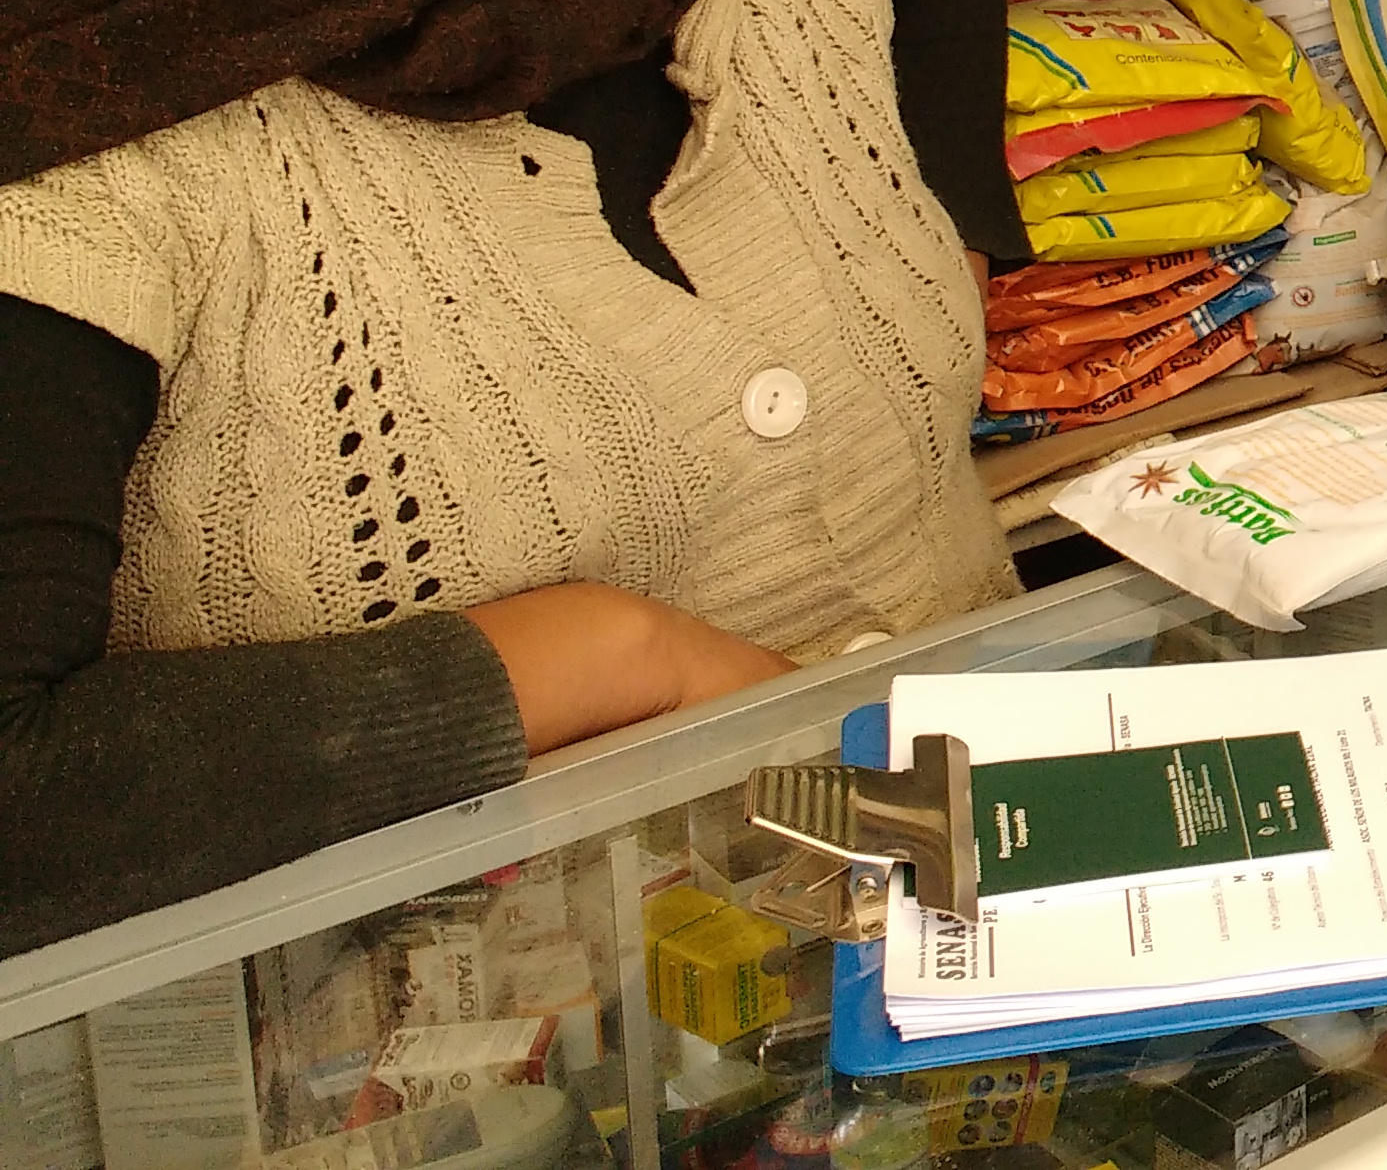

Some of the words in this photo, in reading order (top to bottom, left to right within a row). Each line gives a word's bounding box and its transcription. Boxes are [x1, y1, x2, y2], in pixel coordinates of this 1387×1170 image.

[1120, 715, 1131, 739] SENASA
[1261, 871, 1274, 882] 46
[982, 909, 998, 923] PE
[1140, 914, 1152, 943] Dirección
[1142, 944, 1153, 953] La
